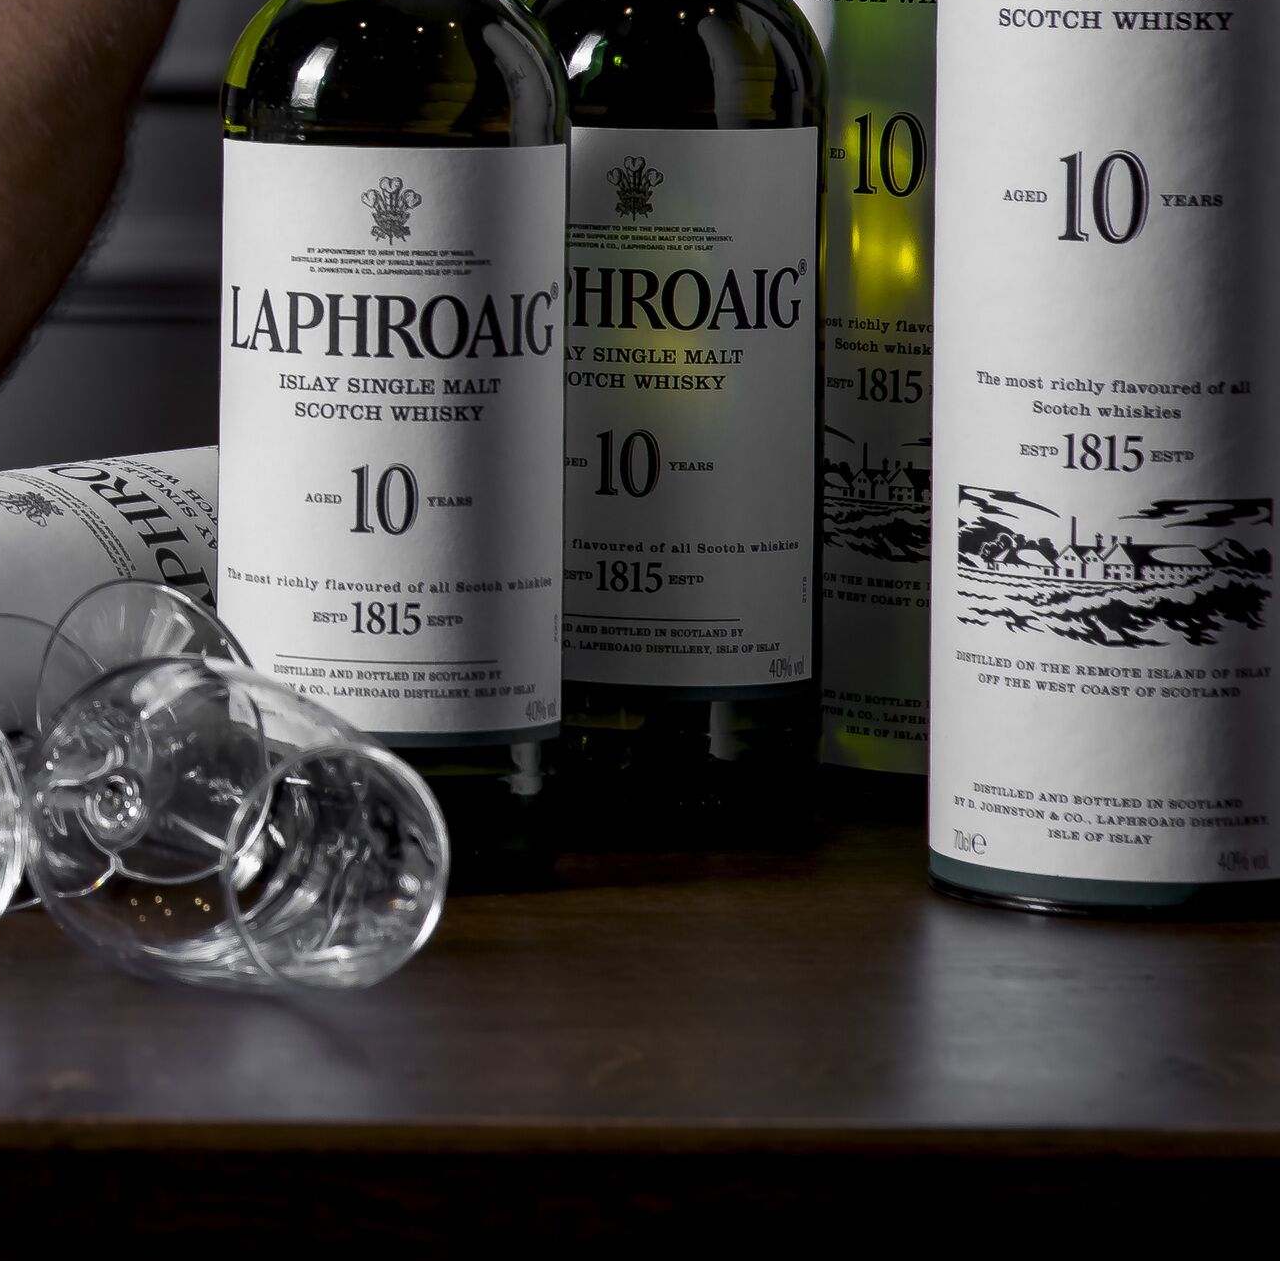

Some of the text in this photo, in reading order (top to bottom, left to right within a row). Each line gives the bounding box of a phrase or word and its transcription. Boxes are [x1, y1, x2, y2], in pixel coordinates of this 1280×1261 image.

[998, 8, 1233, 32] SCOTCH WHISKY
[853, 111, 927, 197] 10
[1003, 149, 1224, 244] AGED 10 YEARS
[848, 318, 890, 334] richly
[593, 347, 676, 364] SINGLE
[683, 349, 744, 364] MALT
[835, 338, 880, 352] Scotch
[279, 373, 502, 396] ISLAY SINGLE MALT
[634, 374, 726, 390] WHISKY
[856, 366, 924, 404] 1815
[976, 370, 1252, 396] The most richly flavoured of all
[294, 402, 485, 422] SCOTCH WHISKY
[1033, 400, 1182, 420] Scotch whiskies
[595, 428, 661, 498] 10
[669, 460, 714, 472] YEARS
[1019, 432, 1194, 472] ESTD 1815 ESTD
[305, 462, 473, 536] AGED 10 YEARS
[572, 538, 800, 554] flavoured of all Scotch whiskies
[245, 572, 271, 585] most
[277, 576, 320, 592] richly
[325, 578, 401, 594] flavoured
[408, 581, 425, 594] of
[429, 581, 450, 594] all
[456, 580, 504, 592] Scotch
[596, 560, 664, 594] 1815
[668, 574, 704, 586] ESTD
[312, 610, 348, 624] ESTD
[351, 600, 422, 636] 1815
[576, 624, 598, 635] AND
[601, 626, 650, 637] BOTTLED
[654, 628, 666, 637] IN
[670, 628, 729, 638] SCOTLAND
[731, 628, 744, 638] BY
[579, 641, 642, 652] LAPHROAIG
[716, 644, 738, 654] ISLE
[741, 644, 754, 654] OF
[756, 642, 780, 652] ISLAY
[273, 663, 326, 678] DISTILLED
[329, 668, 353, 680] AND
[357, 670, 408, 682] BOTTLED
[412, 672, 426, 682] IN
[429, 671, 486, 682] SCOTLAND
[768, 656, 804, 678] 40% vol
[956, 650, 1012, 668] DISTILLED
[1016, 660, 1035, 672] ON
[1040, 662, 1070, 674] THE
[1075, 665, 1142, 678] REMOTE
[1148, 668, 1206, 680] ISLAND
[1211, 668, 1230, 680] OF
[334, 687, 400, 699] LAPHROAIG
[978, 673, 1241, 698] OFF THE WEST COAST OF SCOTLAND
[973, 782, 1243, 810] DISTILLED AND BOTTLED IN SCOTLAND
[954, 796, 966, 806] BY
[981, 802, 1046, 820] JOHNSTON
[1049, 811, 1060, 822] &
[1096, 814, 1186, 828] LAPHROAIG
[1047, 828, 1152, 844] ISLE OF ISLAY
